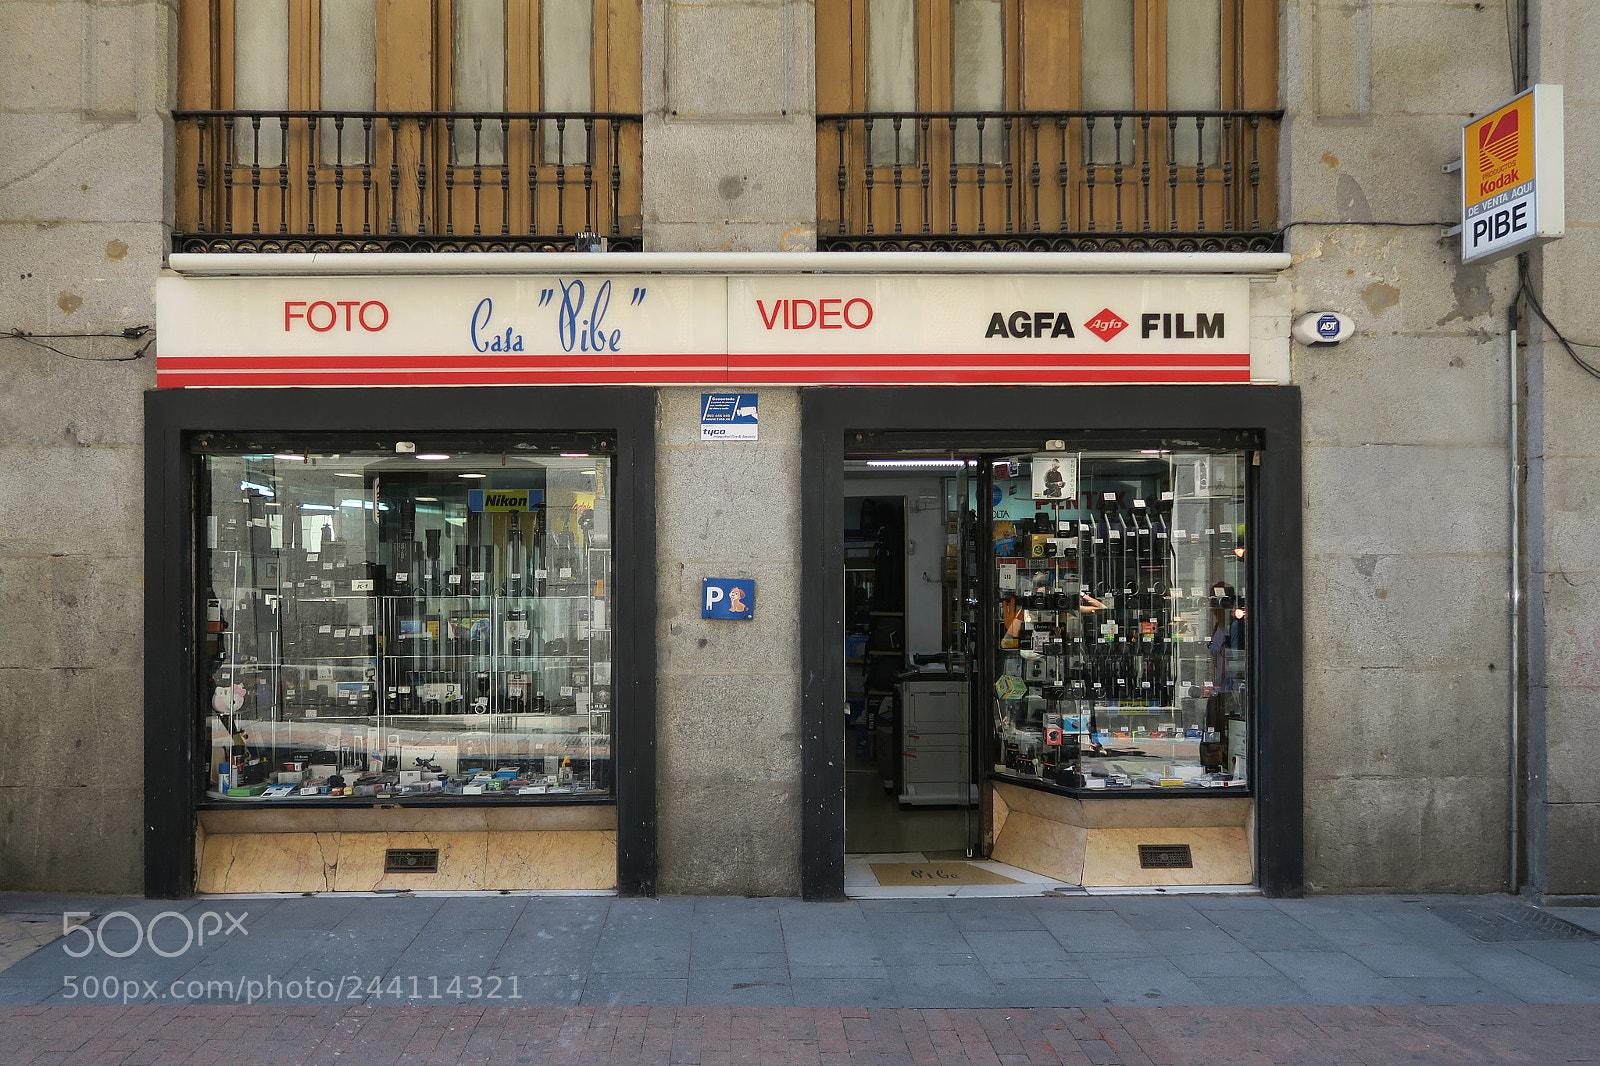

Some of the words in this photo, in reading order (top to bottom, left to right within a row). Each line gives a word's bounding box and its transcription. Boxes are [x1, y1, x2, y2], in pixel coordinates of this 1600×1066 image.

[1480, 169, 1520, 196] Kodak
[1482, 160, 1516, 180] PRODUCTOS
[1468, 205, 1480, 216] DE
[1482, 193, 1508, 210] VENTA
[1511, 182, 1532, 199] AQUI
[1473, 201, 1528, 248] PIBE
[284, 300, 389, 333] FOTO
[471, 298, 524, 353] Casa
[756, 298, 874, 330] VIDEO
[985, 311, 1075, 339] AGFA
[1090, 319, 1122, 331] Agfa
[1141, 313, 1225, 339] FILM
[1320, 322, 1337, 331] ADT
[703, 428, 726, 436] tyco
[485, 494, 528, 507] Nikon
[706, 586, 724, 611] P
[910, 869, 958, 880] Pibe
